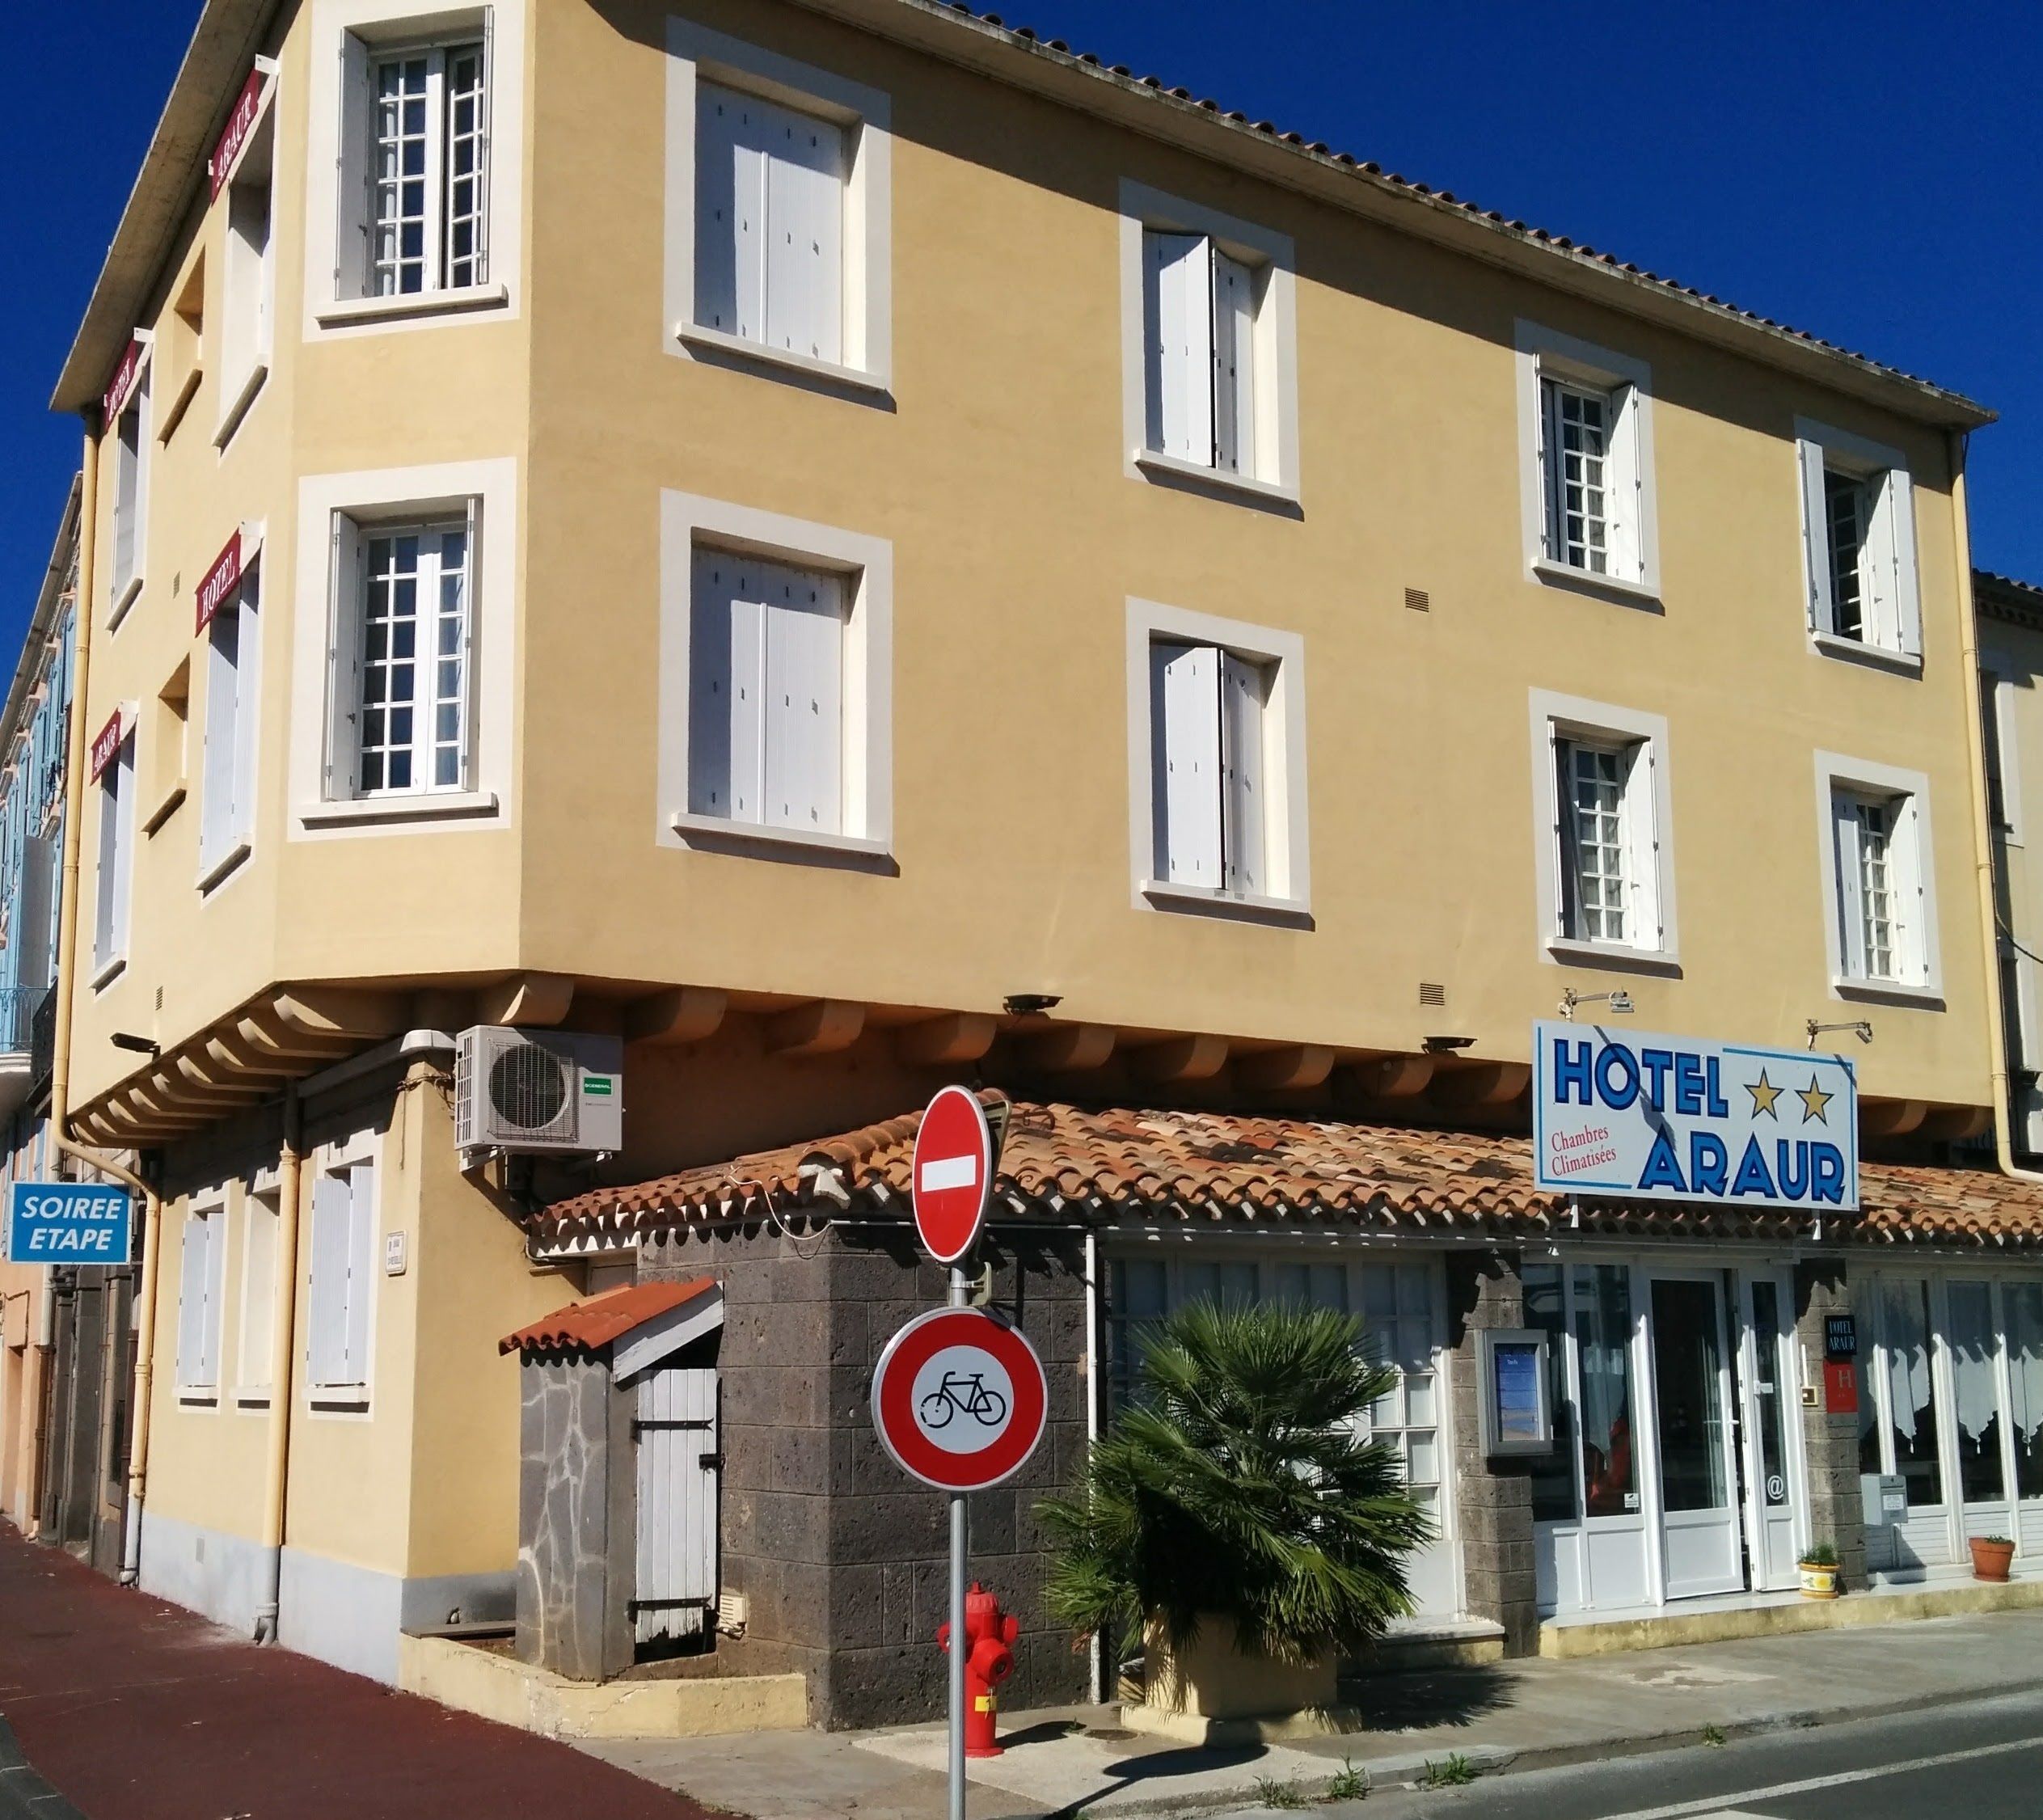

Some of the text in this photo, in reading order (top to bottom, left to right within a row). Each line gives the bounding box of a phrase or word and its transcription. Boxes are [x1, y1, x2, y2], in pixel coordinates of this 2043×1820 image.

[217, 91, 251, 188] ARAUR
[201, 551, 235, 623] HOTEL
[1553, 1038, 1729, 1119] HOTEL
[1551, 1124, 1609, 1152] Chambres
[1551, 1144, 1617, 1176] Climatisées
[1636, 1122, 1846, 1206] ARAUR
[21, 1196, 123, 1219] SOIREE
[28, 1227, 113, 1251] ETAPE
[1829, 1320, 1853, 1334] HOTEL
[1829, 1336, 1855, 1350] ARAUR
[1838, 1370, 1853, 1388] H
